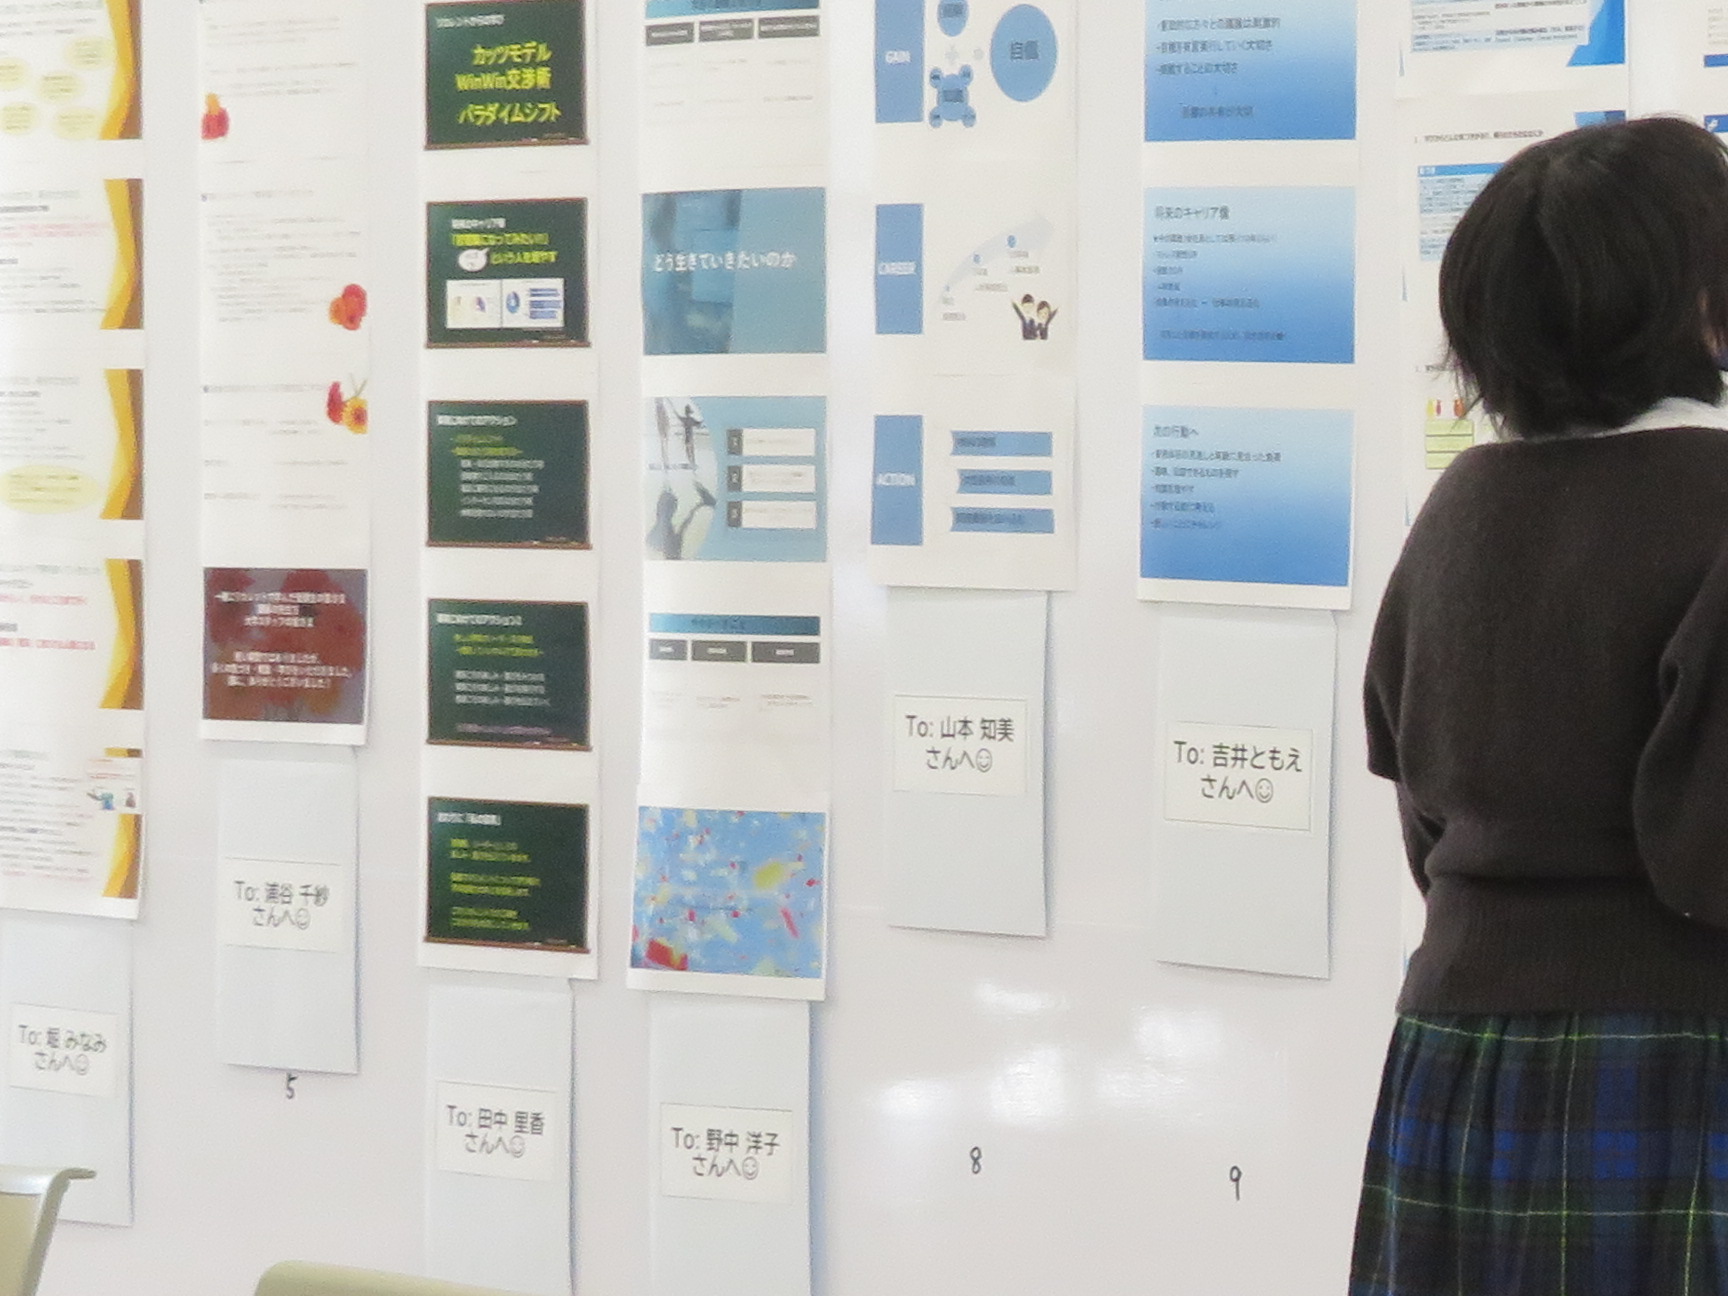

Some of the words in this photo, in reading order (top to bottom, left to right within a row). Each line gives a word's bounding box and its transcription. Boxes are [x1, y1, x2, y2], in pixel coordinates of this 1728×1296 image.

[472, 41, 552, 65] カッツモデル
[456, 67, 551, 91] WinWin交渉術
[457, 102, 561, 125] パラダイムシフト
[652, 251, 798, 273] どう生きていきたいのか
[905, 714, 934, 739] To:
[940, 716, 974, 741] 山本
[980, 718, 1015, 743] 知美
[924, 747, 976, 771] さんへ
[1173, 740, 1204, 766] To:
[1211, 742, 1303, 774] 吉井ともえ
[1200, 775, 1254, 801] さんへ
[234, 880, 260, 902] To:
[253, 907, 295, 927] さんへ
[64, 1030, 107, 1053] みなみ
[34, 1051, 76, 1071] さんへ
[447, 1104, 473, 1127] To:
[478, 1108, 508, 1130] 田中
[514, 1110, 545, 1136] 里香
[465, 1131, 510, 1154] さんへ
[671, 1126, 701, 1150] To:
[706, 1128, 739, 1153] 野中
[745, 1131, 780, 1156] 洋子
[692, 1154, 742, 1178] さんへ
[969, 1146, 983, 1175] 8
[1230, 1165, 1243, 1202] 9
